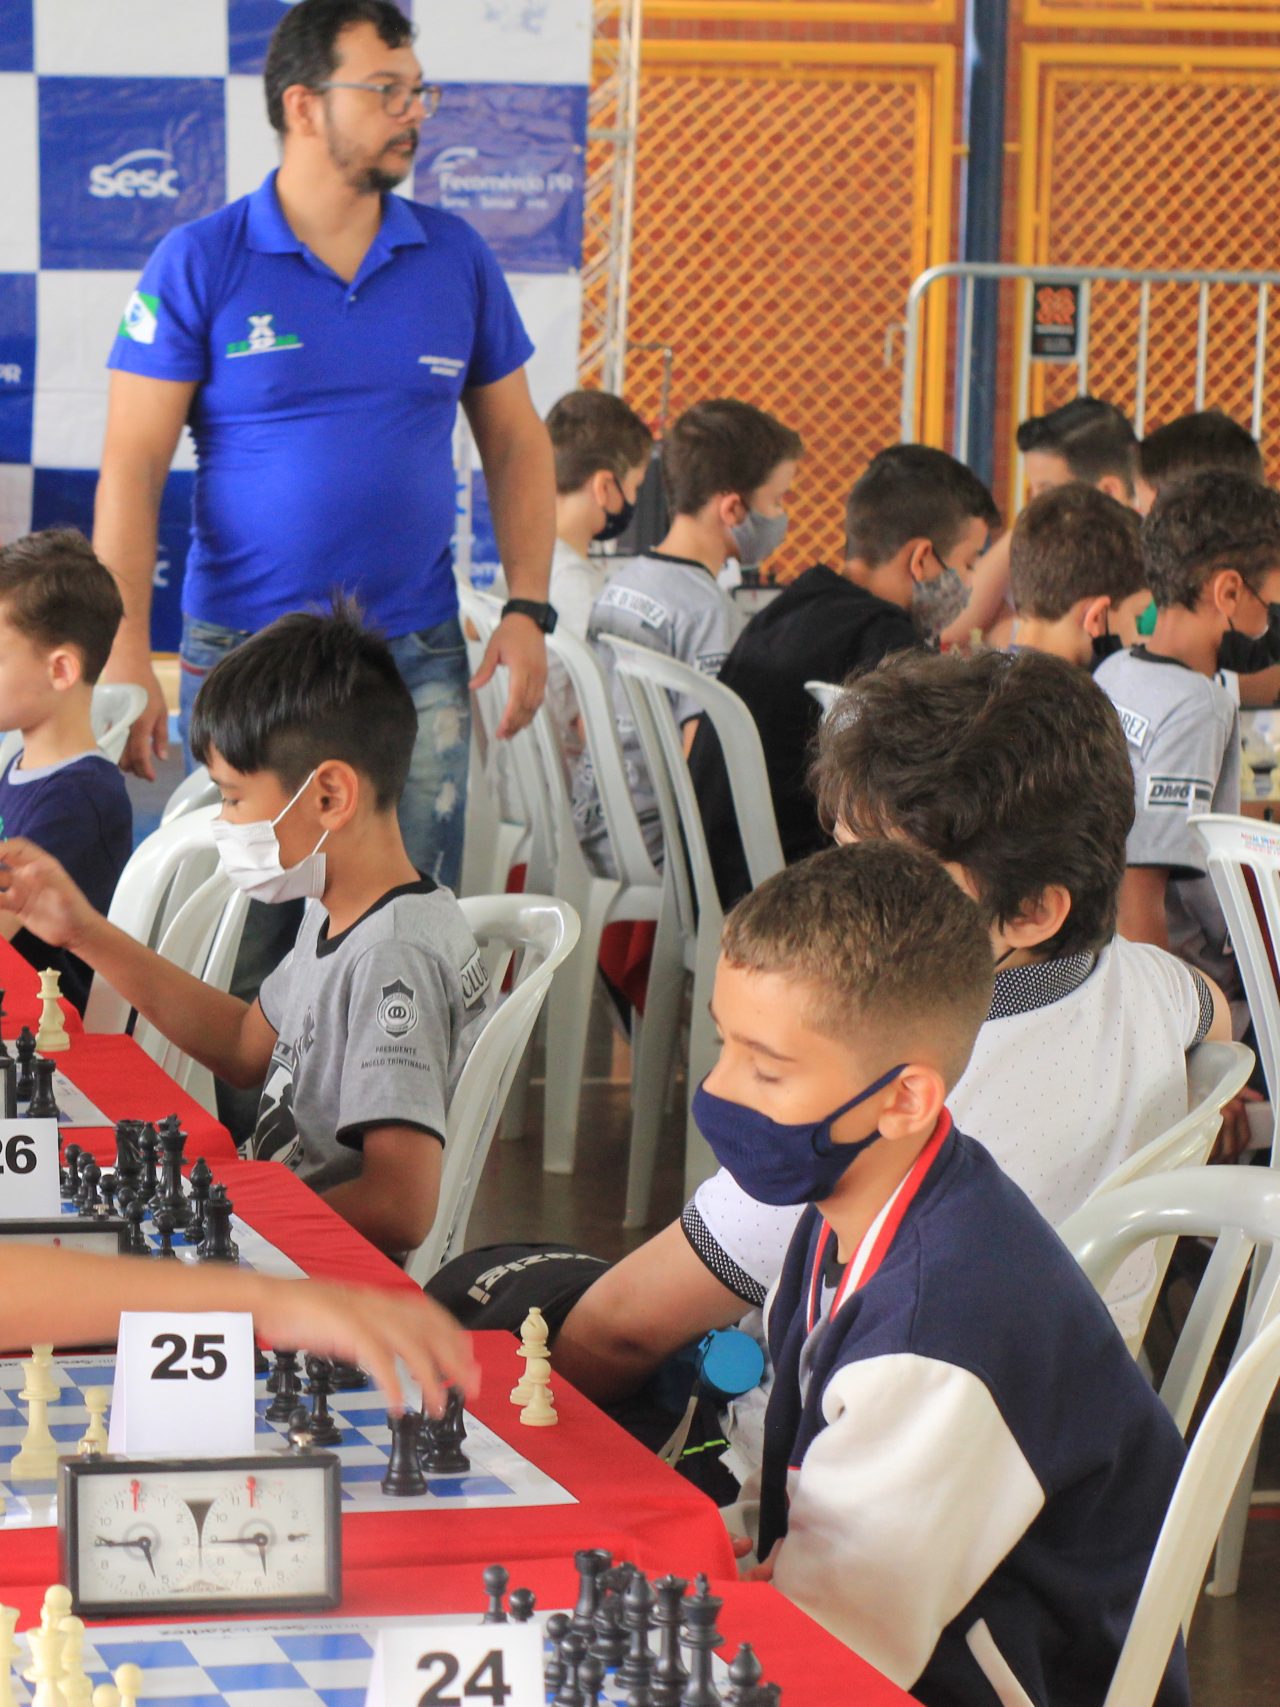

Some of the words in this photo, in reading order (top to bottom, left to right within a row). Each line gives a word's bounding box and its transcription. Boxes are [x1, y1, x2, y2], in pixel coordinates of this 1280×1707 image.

[88, 164, 180, 198] Sesc
[546, 173, 574, 193] PR
[150, 1333, 228, 1381] 25
[417, 1649, 512, 1707] 24
